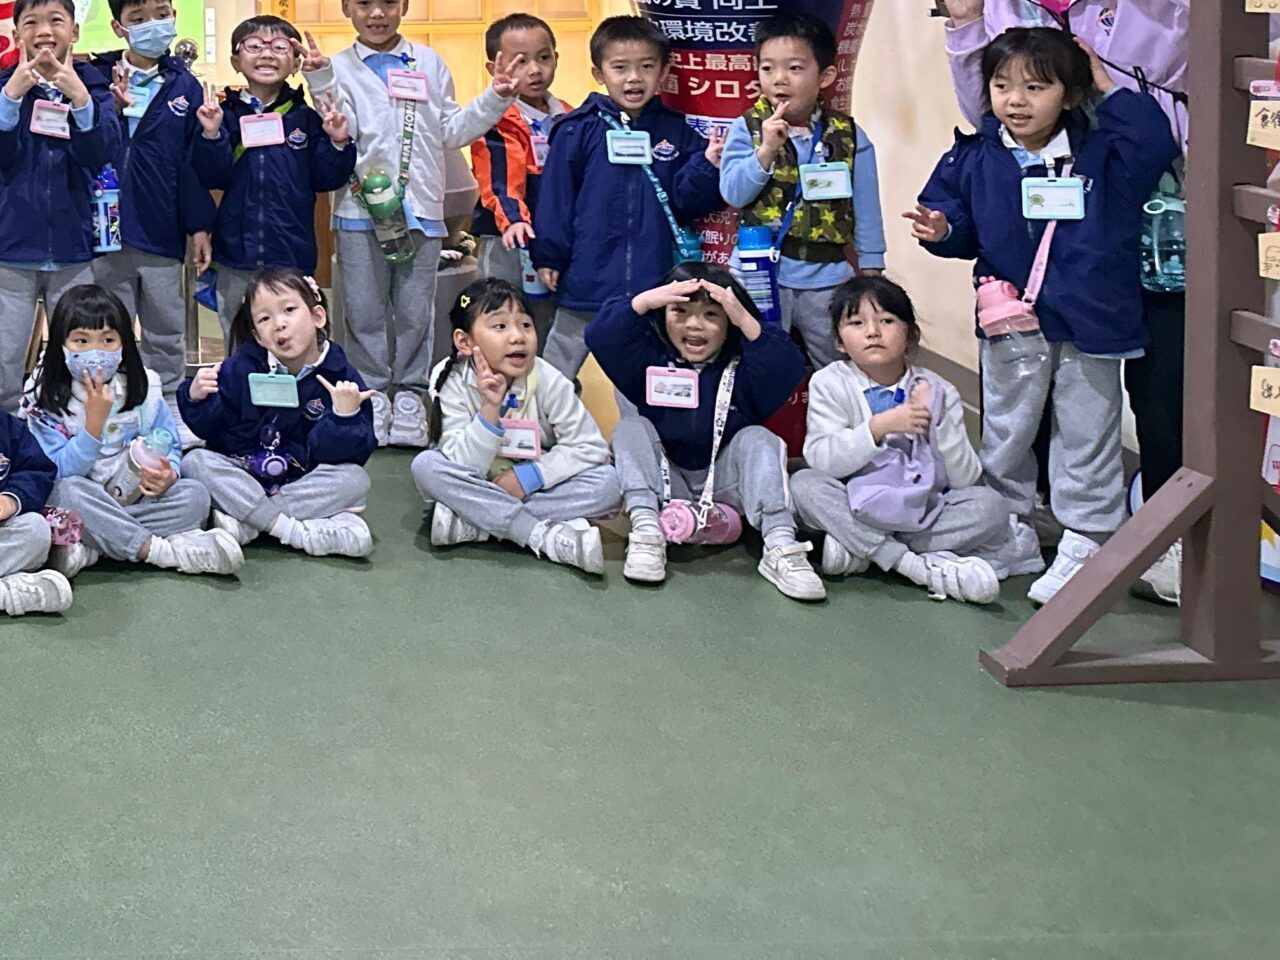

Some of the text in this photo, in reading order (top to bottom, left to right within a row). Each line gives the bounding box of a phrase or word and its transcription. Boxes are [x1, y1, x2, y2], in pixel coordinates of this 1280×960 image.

[650, 19, 757, 42] 環境改
[668, 52, 759, 71] 史上最高
